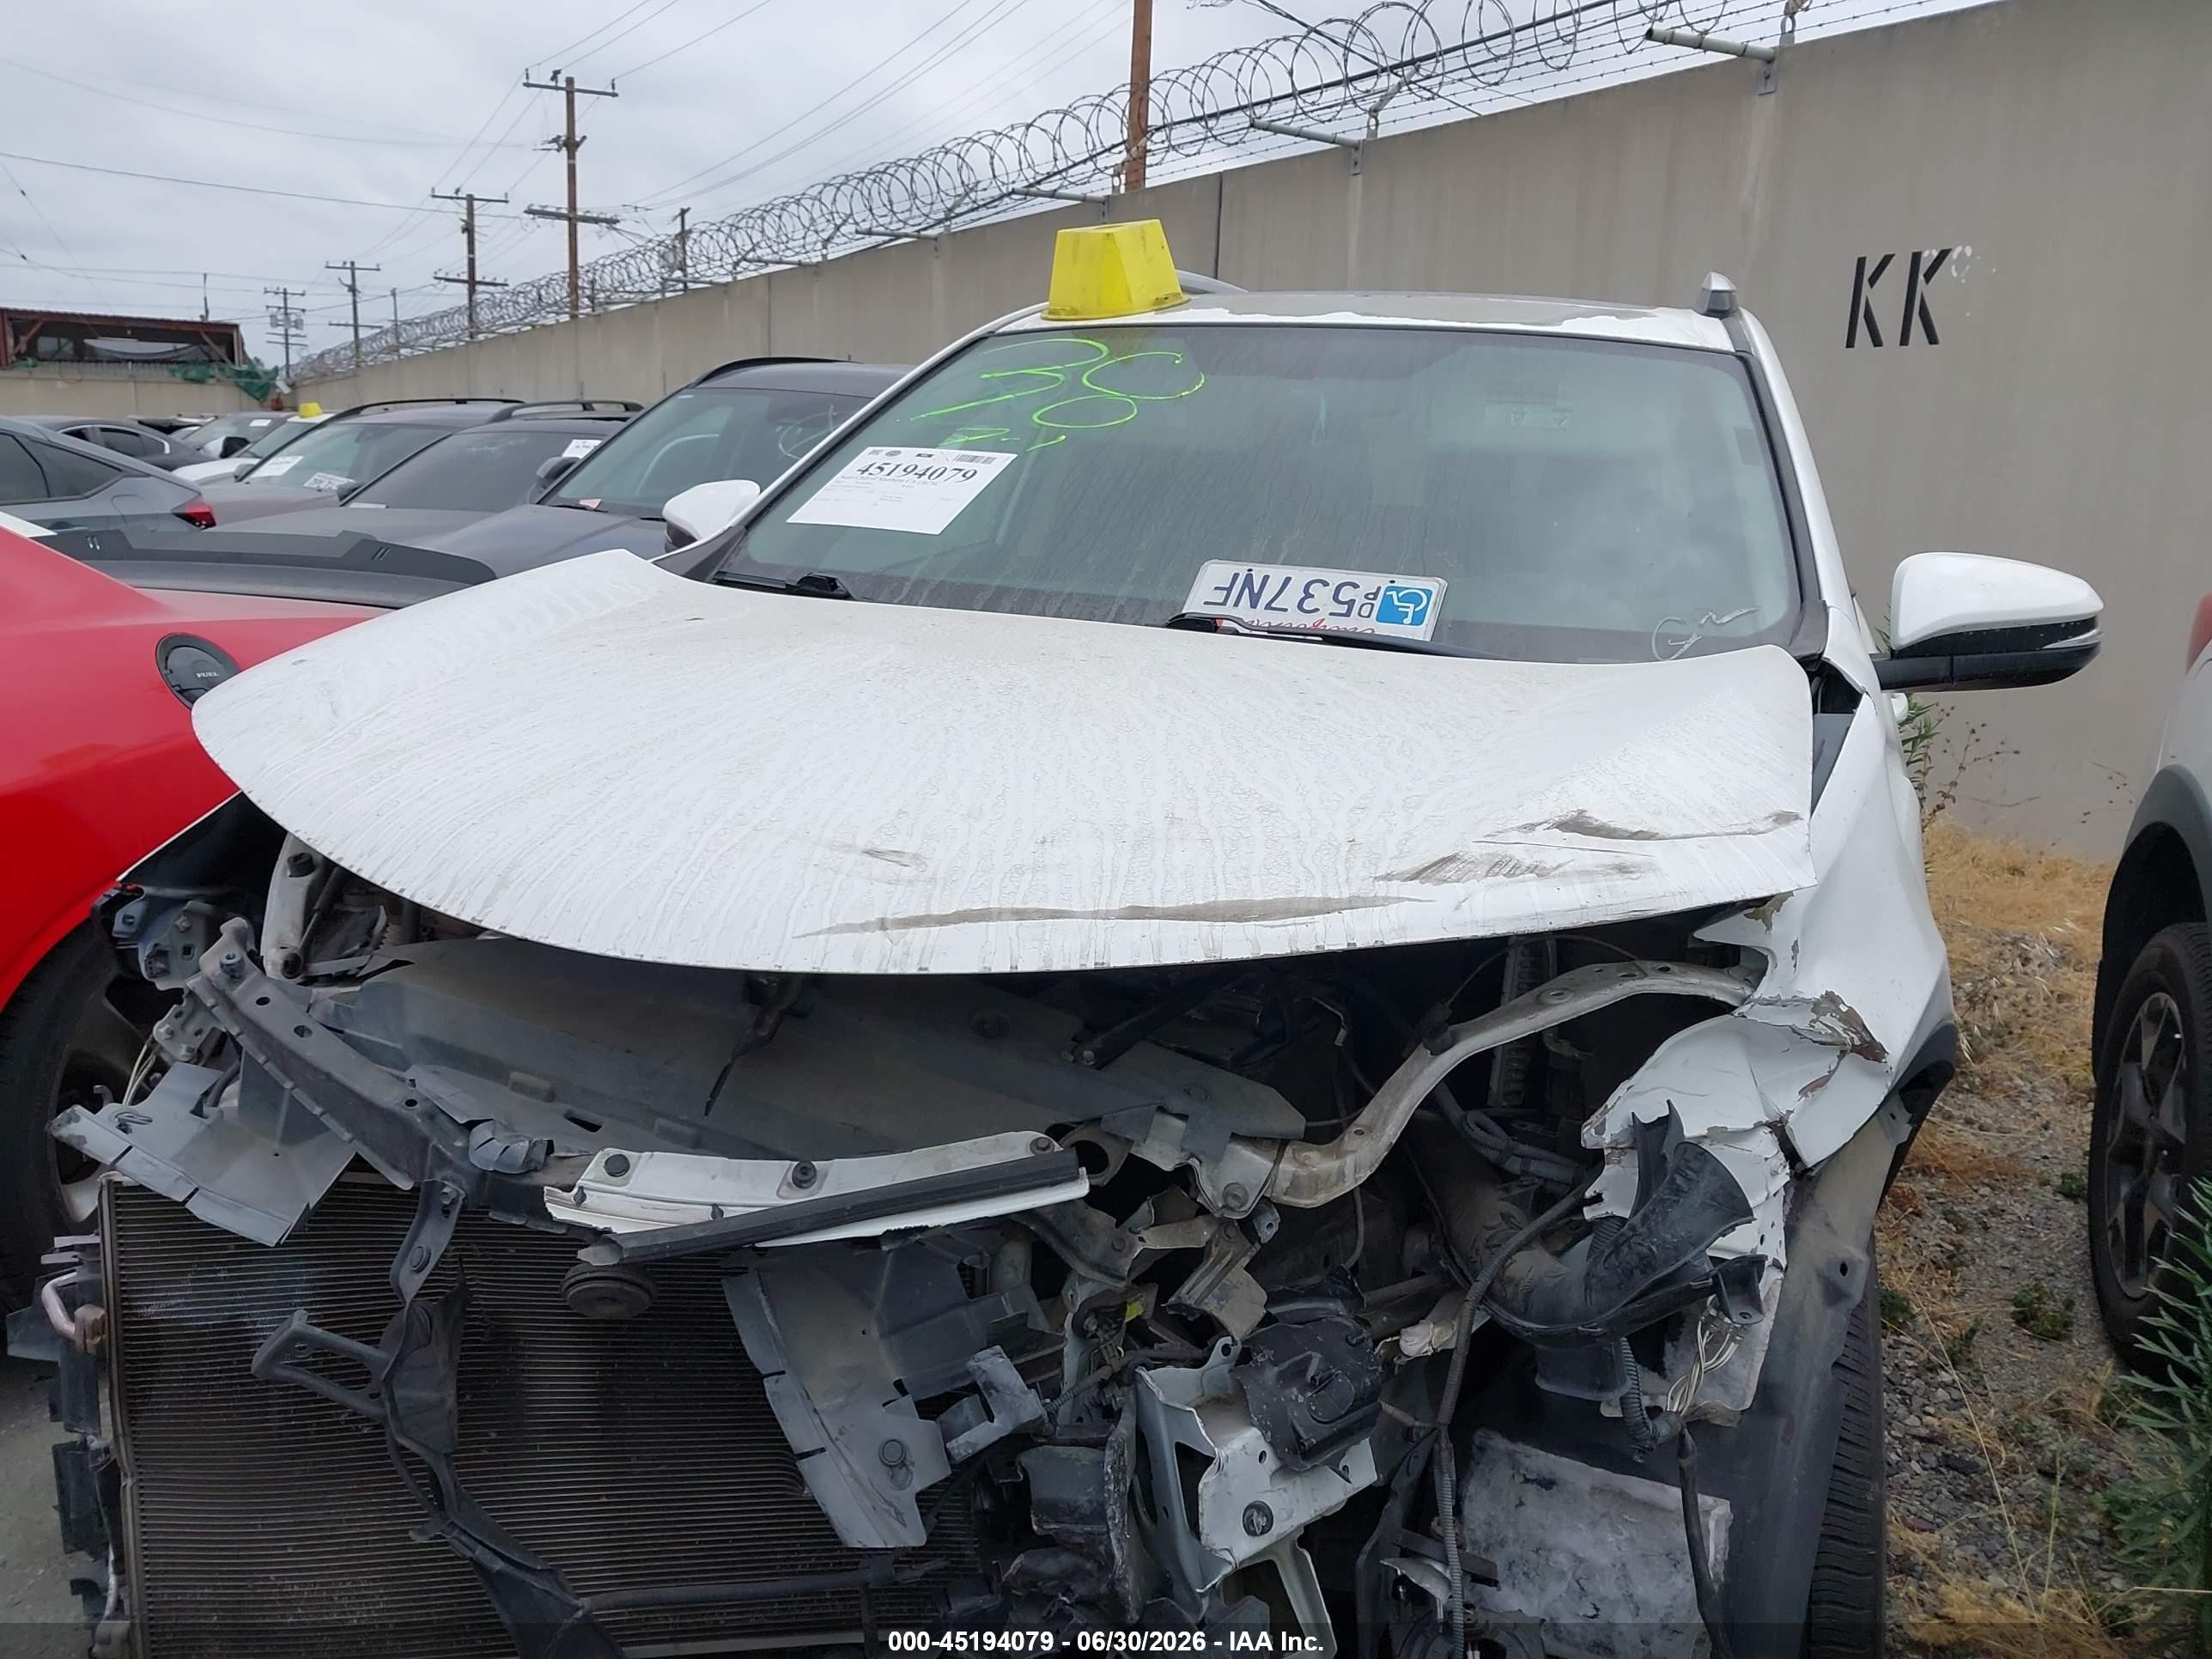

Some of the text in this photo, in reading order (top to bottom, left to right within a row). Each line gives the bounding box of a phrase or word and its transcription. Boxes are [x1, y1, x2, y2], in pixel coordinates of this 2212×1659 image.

[1845, 247, 1953, 349] KK
[856, 460, 978, 483] 45194079
[1202, 572, 1361, 620] 537NF
